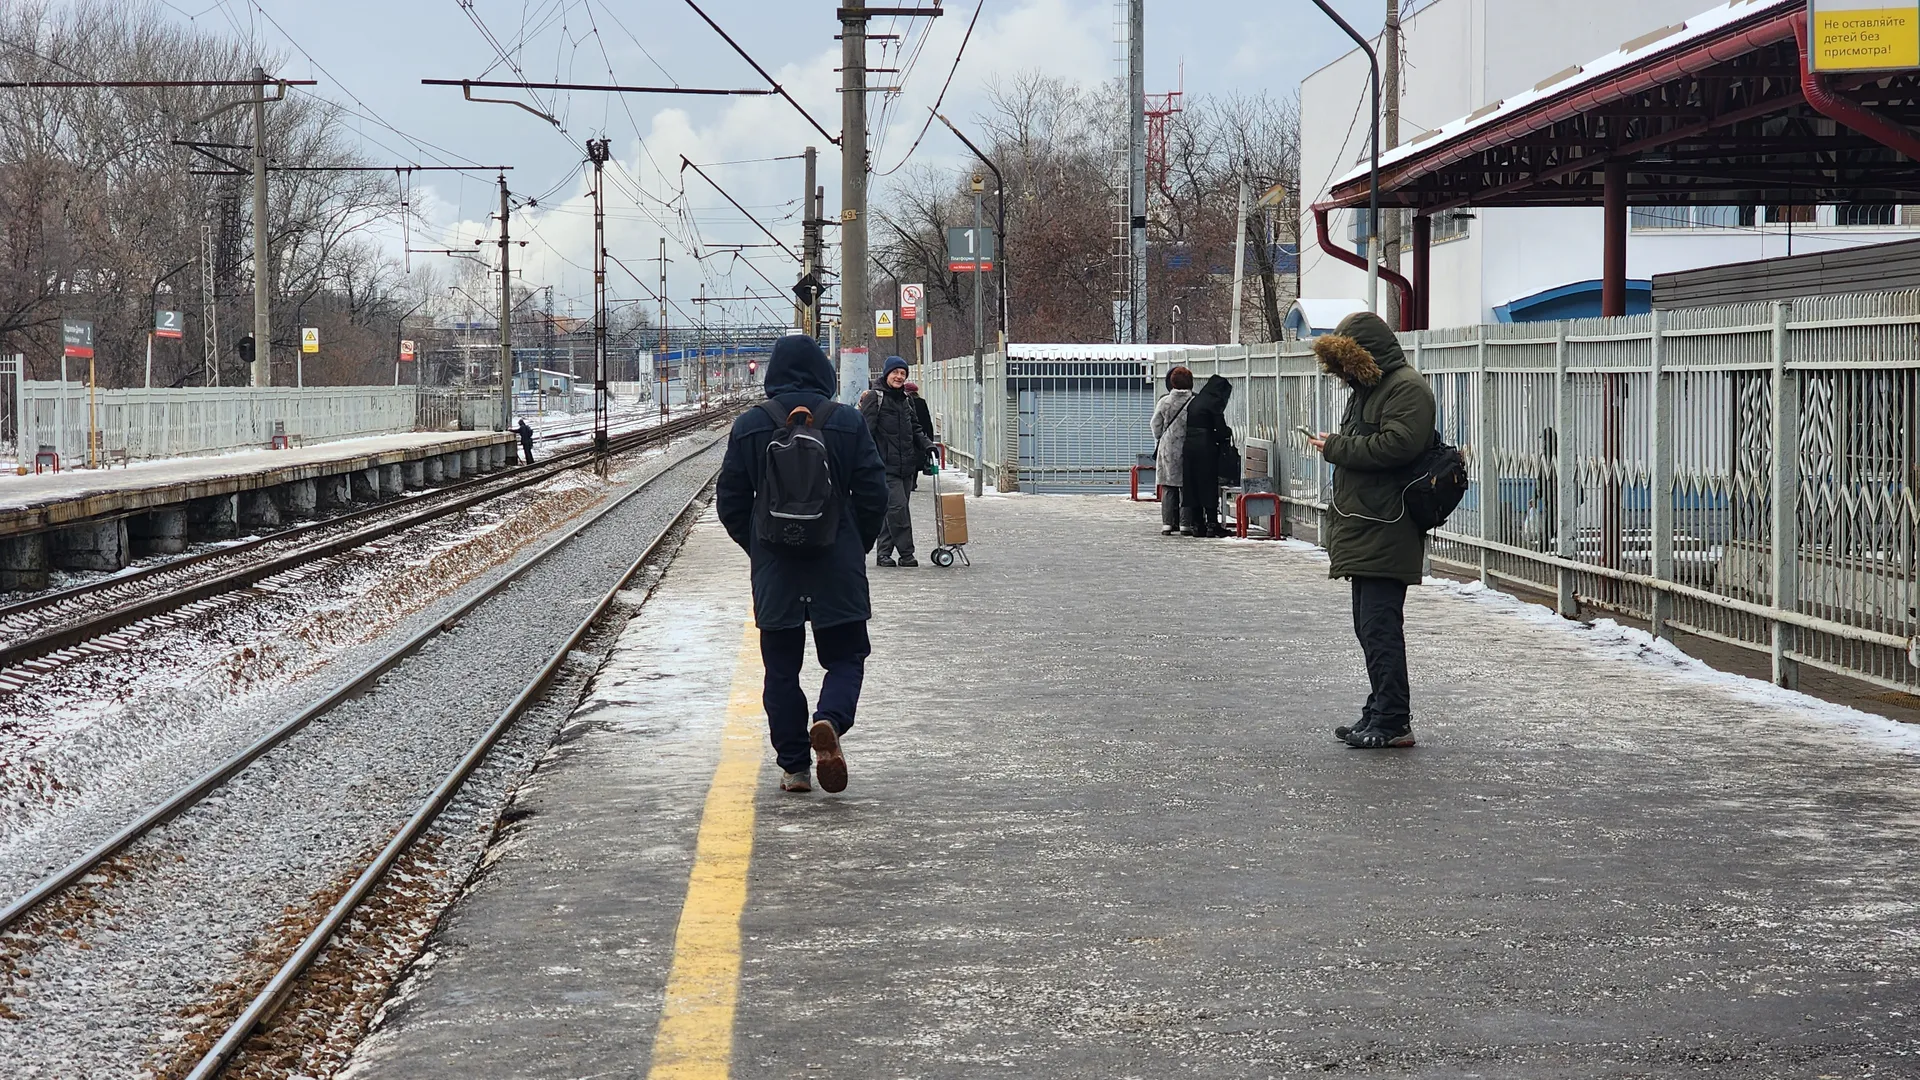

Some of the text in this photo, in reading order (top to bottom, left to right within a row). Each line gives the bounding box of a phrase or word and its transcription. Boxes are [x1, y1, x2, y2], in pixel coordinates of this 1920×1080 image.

[1824, 16, 1905, 29] Не оставляйте
[1824, 31, 1880, 44] детей без
[1824, 44, 1891, 58] присмотра!
[964, 229, 974, 254] 1
[164, 311, 175, 327] 2
